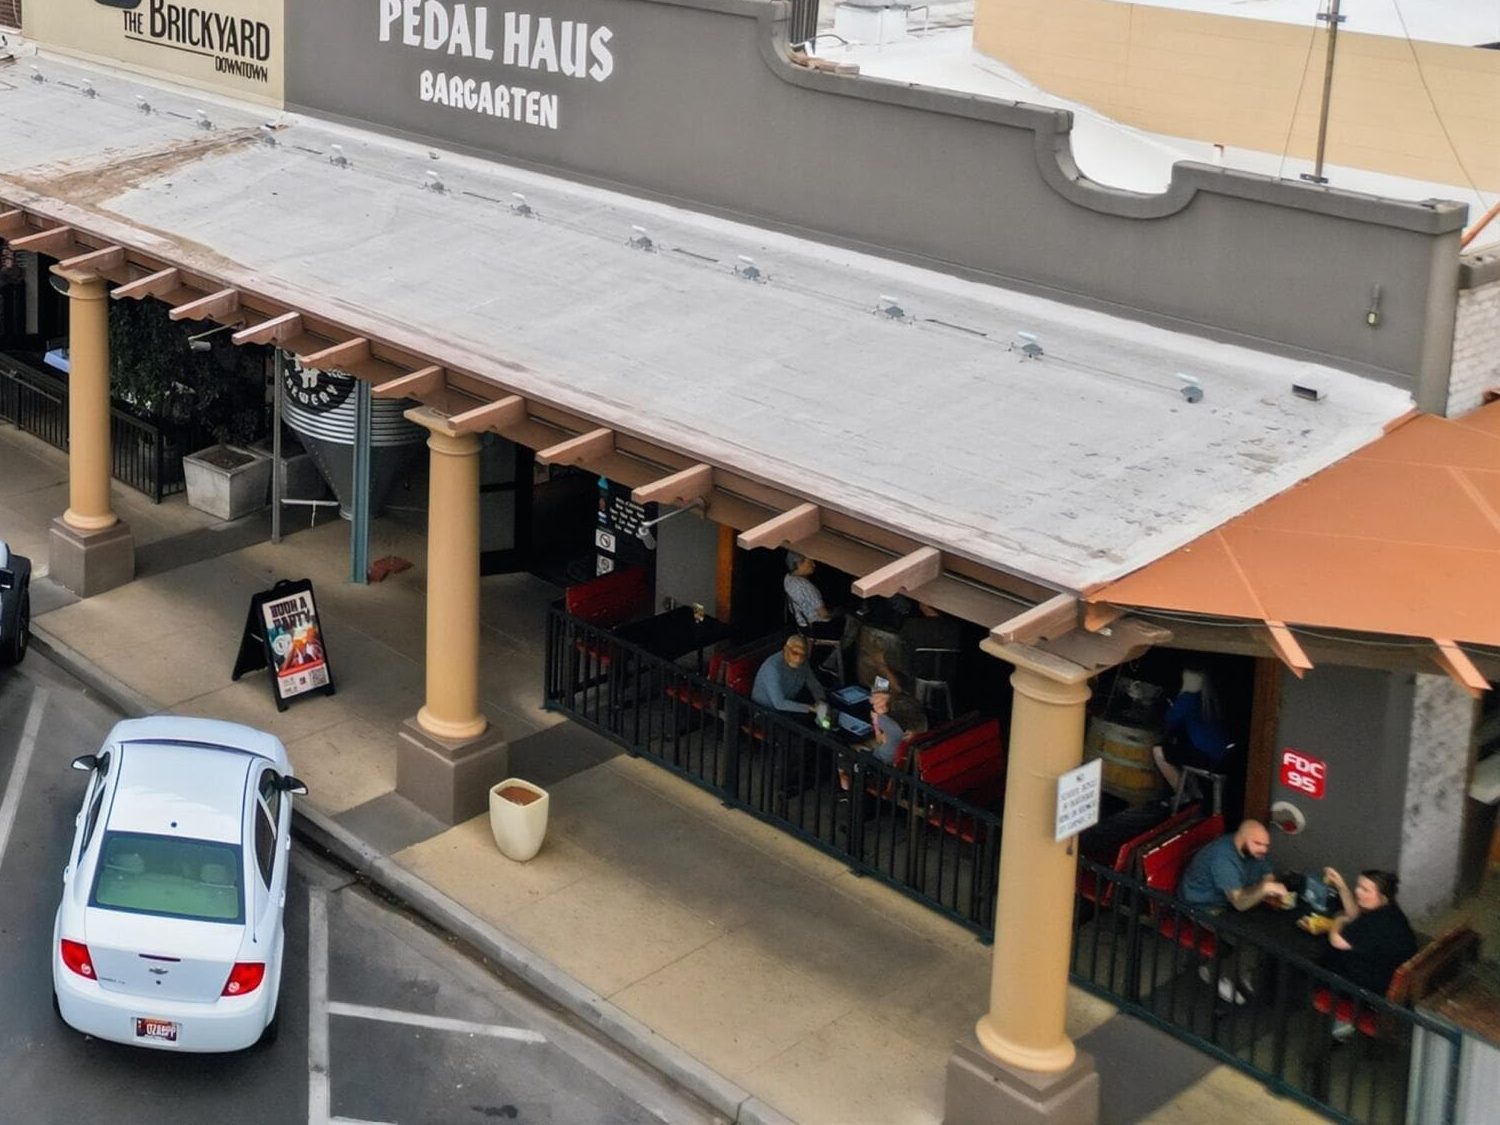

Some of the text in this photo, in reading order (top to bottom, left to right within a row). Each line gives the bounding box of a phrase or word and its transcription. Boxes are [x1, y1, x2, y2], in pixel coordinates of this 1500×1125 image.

[123, 10, 144, 35] THE
[503, 11, 614, 83] HAUS
[215, 55, 268, 83] DOWNTOWN
[420, 69, 558, 129] BARGARTEN
[299, 596, 307, 610] A
[272, 608, 311, 632] PARTY
[1283, 752, 1324, 779] FDC
[1287, 771, 1316, 793] 95
